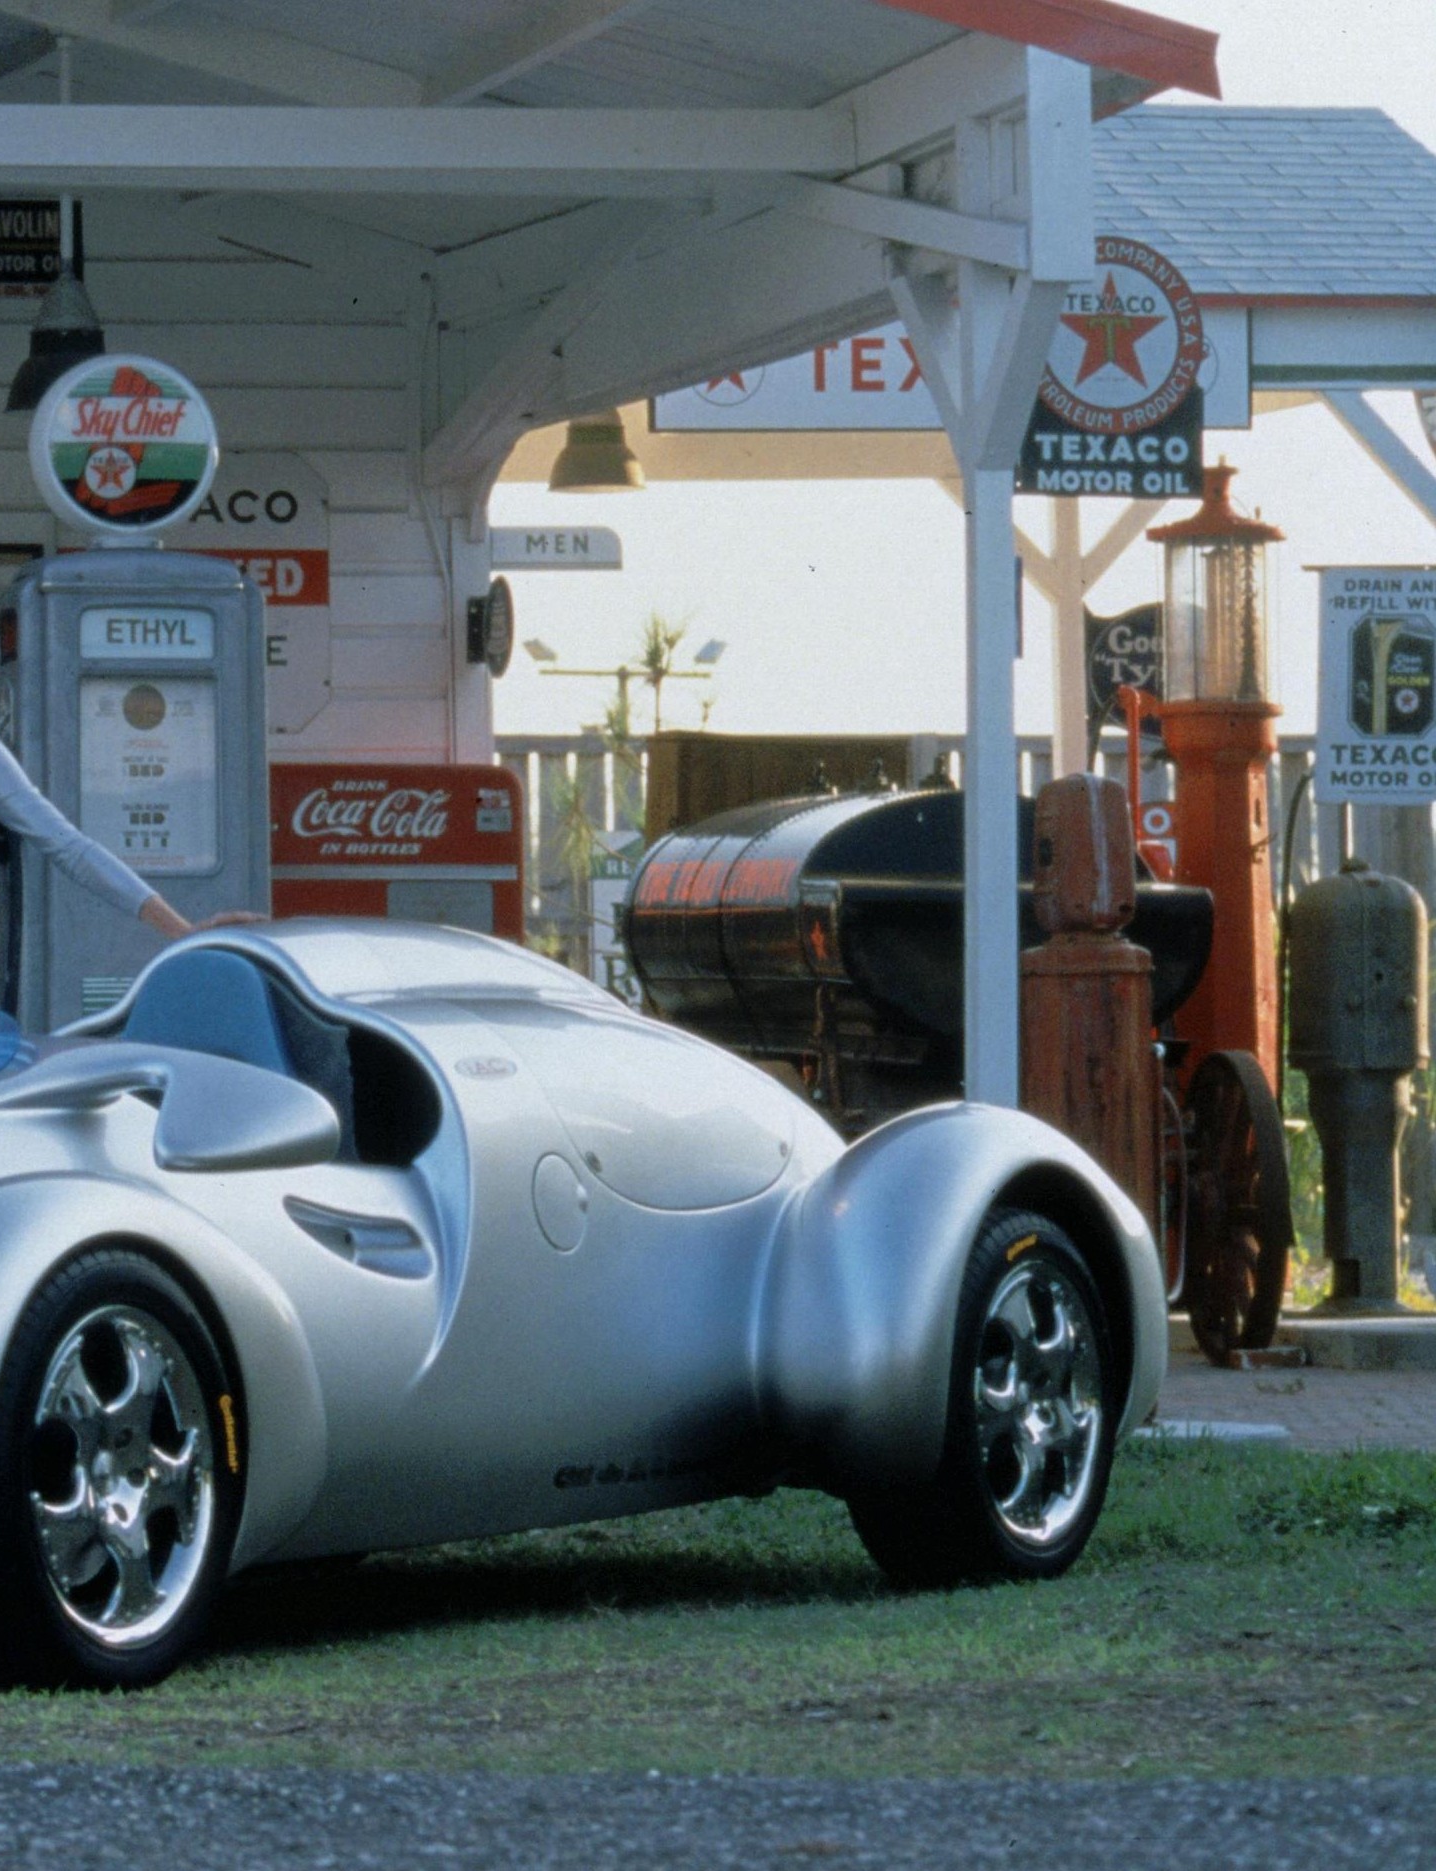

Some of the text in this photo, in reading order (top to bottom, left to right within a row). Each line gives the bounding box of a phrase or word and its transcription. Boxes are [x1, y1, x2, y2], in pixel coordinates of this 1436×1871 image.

[1066, 293, 1156, 314] TEXACO
[1122, 358, 1196, 430] PRODUCTS
[72, 394, 186, 440] Sky Chief
[1035, 434, 1189, 463] TEXACO
[1037, 469, 1190, 494] MOTOR OIL
[525, 534, 589, 554] MEN
[1344, 579, 1436, 593] DRAIN AN
[1333, 596, 1400, 610] REFILL
[107, 618, 196, 646] ETHYL
[1330, 743, 1436, 764] TEXAC
[332, 779, 388, 792] DRINK
[1330, 770, 1408, 787] MOTOR
[292, 788, 451, 839] Coca-Cola
[320, 842, 421, 855] IN BOTTLES
